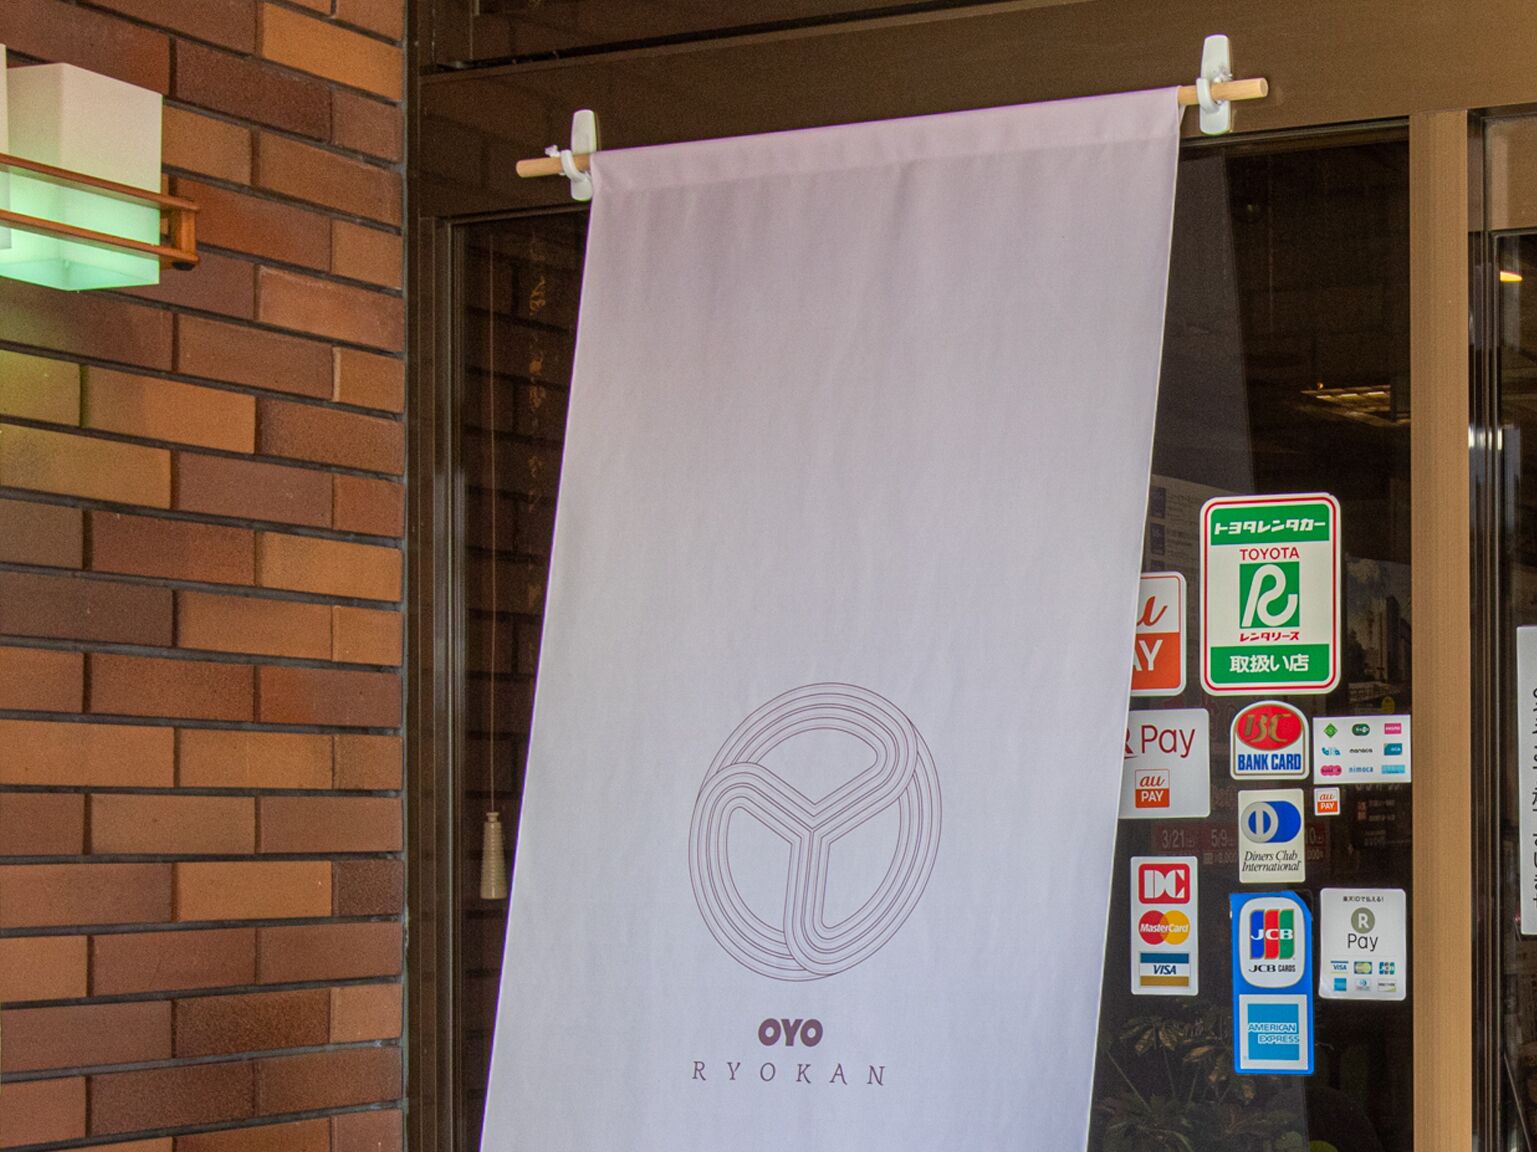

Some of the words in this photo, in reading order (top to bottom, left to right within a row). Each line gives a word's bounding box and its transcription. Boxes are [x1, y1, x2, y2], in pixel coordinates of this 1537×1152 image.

[1213, 517, 1327, 535] トヨタレンタカー
[1239, 546, 1300, 561] TOYOTA
[1239, 631, 1300, 642] レンタリース
[1229, 653, 1310, 673] 取扱い店
[1140, 724, 1196, 759] Pay
[1237, 753, 1268, 771] BANK
[1271, 753, 1301, 771] CARD
[1138, 775, 1166, 788] au
[1140, 790, 1165, 803] PAY
[1319, 801, 1335, 810] PAY
[1244, 850, 1274, 862] Diners
[1275, 850, 1299, 862] Club
[1241, 861, 1301, 873] International
[1139, 923, 1189, 933] MasterCard
[1250, 928, 1294, 941] JCB
[1347, 932, 1379, 952] Pay
[1153, 964, 1178, 975] VISA
[1248, 965, 1277, 973] JCB
[1278, 964, 1296, 973] CARDS
[757, 1017, 824, 1048] OYO
[1248, 1023, 1296, 1032] AMERICAN
[1258, 1035, 1300, 1044] EXPRESS
[691, 1060, 886, 1086] RYOKAN
